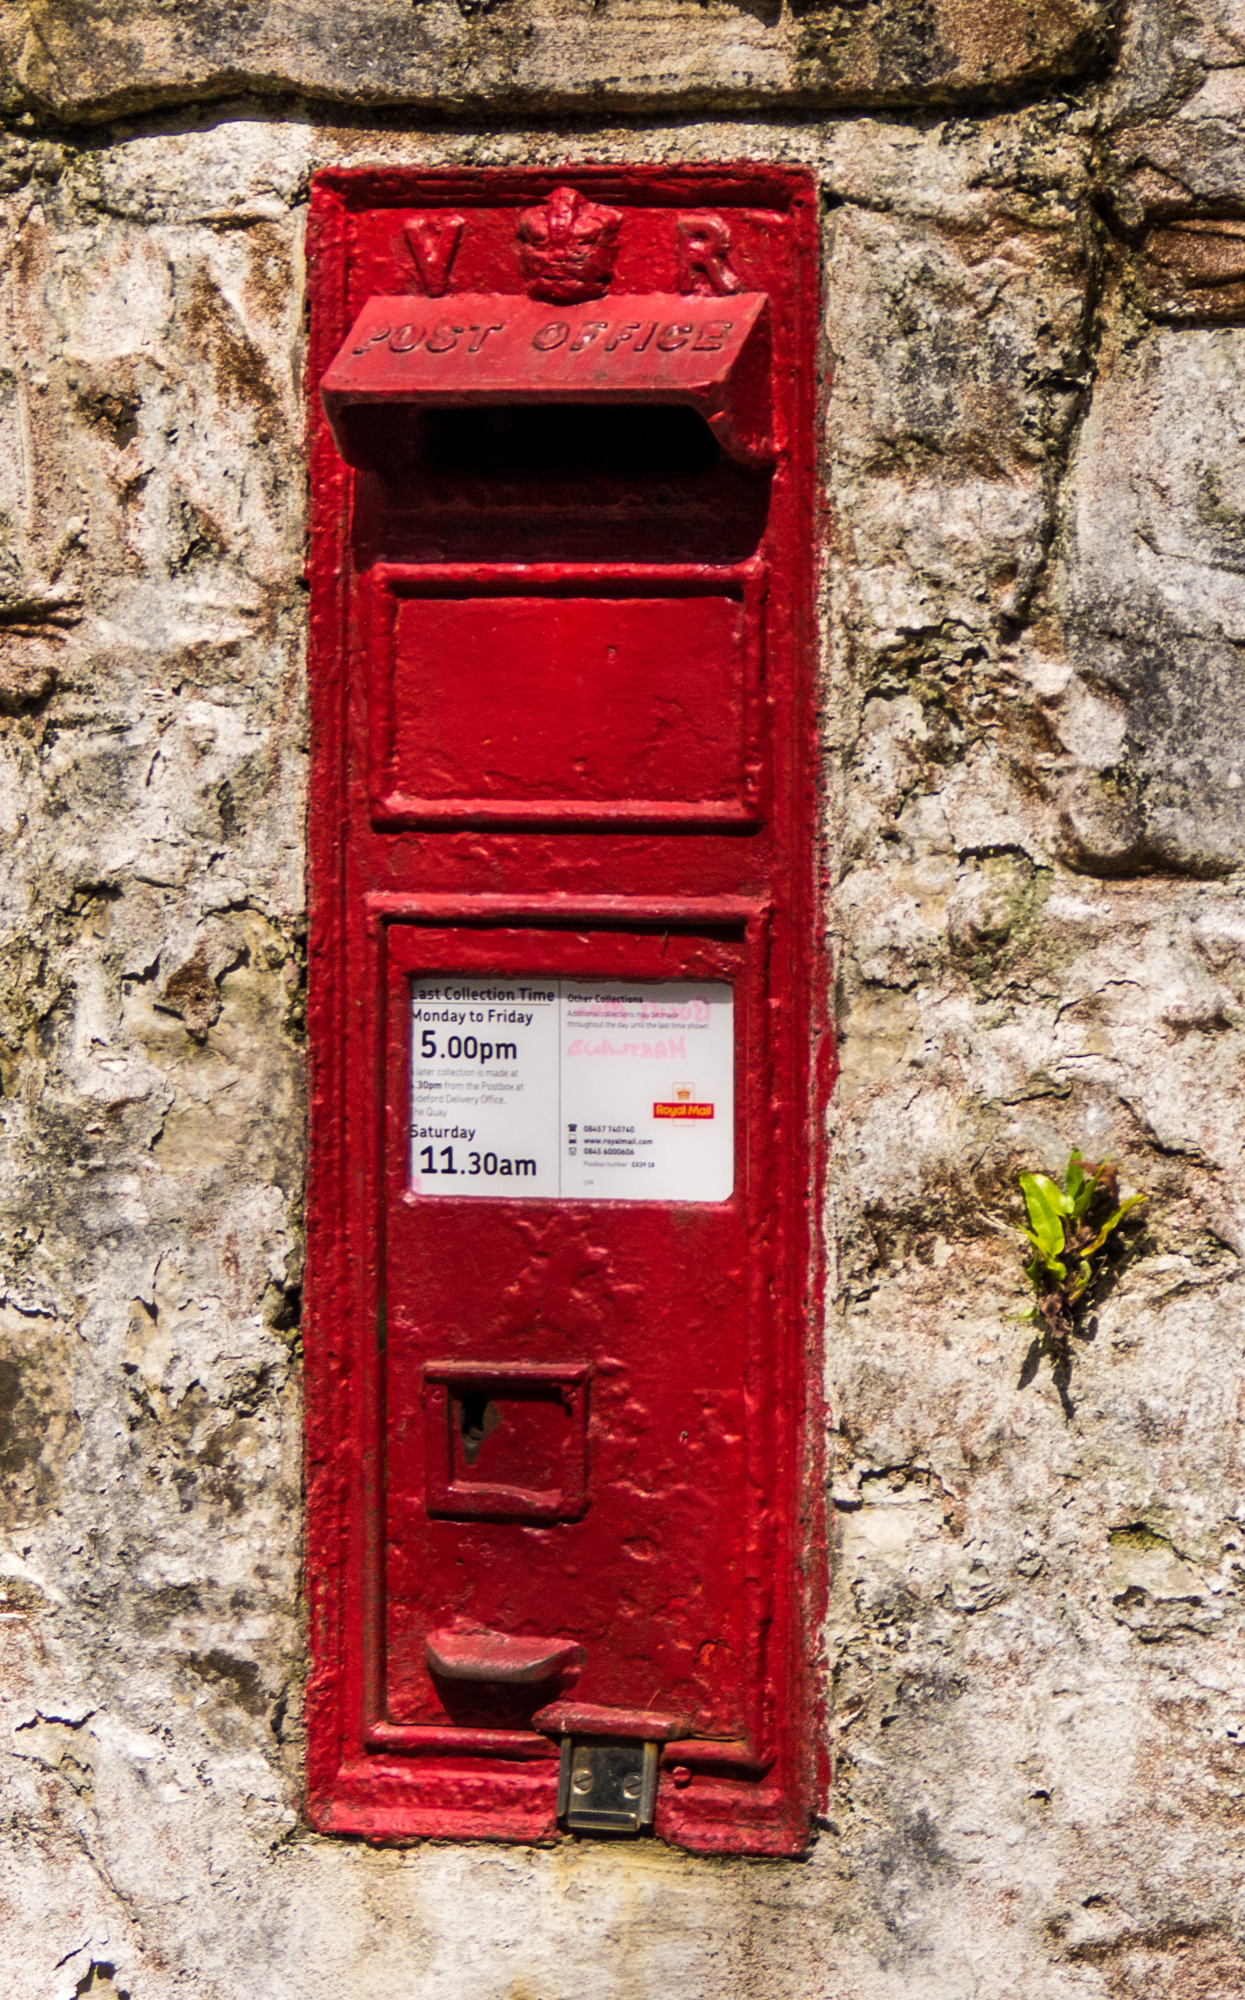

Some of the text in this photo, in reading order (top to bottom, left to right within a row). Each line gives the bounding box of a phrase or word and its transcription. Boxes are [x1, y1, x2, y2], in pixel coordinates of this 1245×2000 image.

[404, 213, 746, 297] V R
[353, 319, 734, 355] POST OFFICE
[444, 986, 515, 1002] Collection
[518, 987, 555, 1002] Time
[567, 993, 645, 1004] Other Collections
[412, 1008, 533, 1027] Monday to Friday
[567, 1010, 600, 1018] Additional
[601, 1010, 635, 1018] collections
[636, 1011, 650, 1020] may
[567, 1020, 604, 1029] throughout
[617, 1021, 629, 1030] day
[630, 1021, 645, 1029] until
[687, 1022, 710, 1030] shown.
[421, 1030, 517, 1064] 5.00pm
[416, 1067, 435, 1077] later
[437, 1067, 475, 1078] collection
[477, 1069, 485, 1078] is
[485, 1068, 509, 1078] made
[510, 1069, 519, 1078] at
[411, 1080, 524, 1092] .30pm from the Postbox at
[446, 1094, 479, 1105] Delivery
[426, 1107, 448, 1118] Quay
[656, 1104, 712, 1117] Royal Mail
[410, 1124, 476, 1142] Saturday
[583, 1125, 635, 1133] 08457 740740
[603, 1148, 635, 1156] 6000606
[420, 1145, 537, 1176] 11.30am
